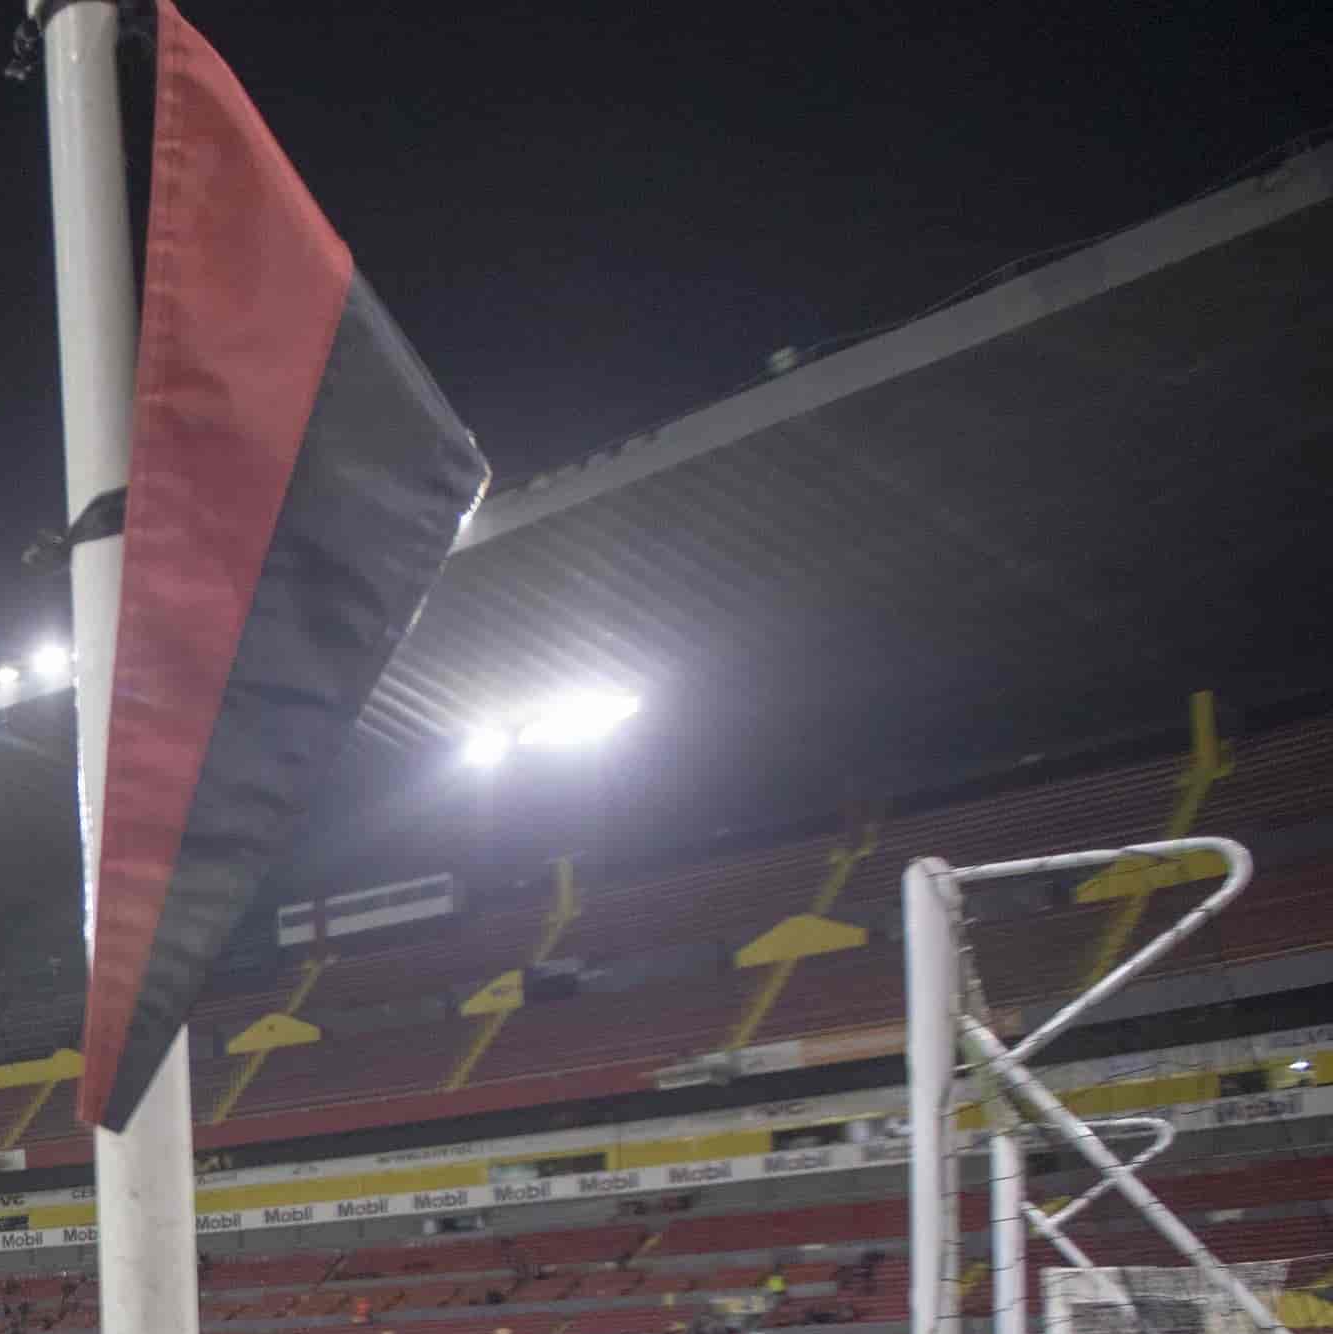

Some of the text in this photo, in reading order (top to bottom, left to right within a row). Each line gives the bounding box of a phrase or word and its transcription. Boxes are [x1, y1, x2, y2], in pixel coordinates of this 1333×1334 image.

[1, 1231, 43, 1249] Mobil
[63, 1227, 99, 1243] Mob
[196, 1213, 242, 1231] Mobil
[263, 1206, 313, 1225] Mobil
[337, 1199, 389, 1217] Mobil
[413, 1190, 468, 1210] Mobil
[494, 1181, 551, 1202] Mobil
[579, 1171, 640, 1193] Mobil
[668, 1160, 732, 1184] Mobil
